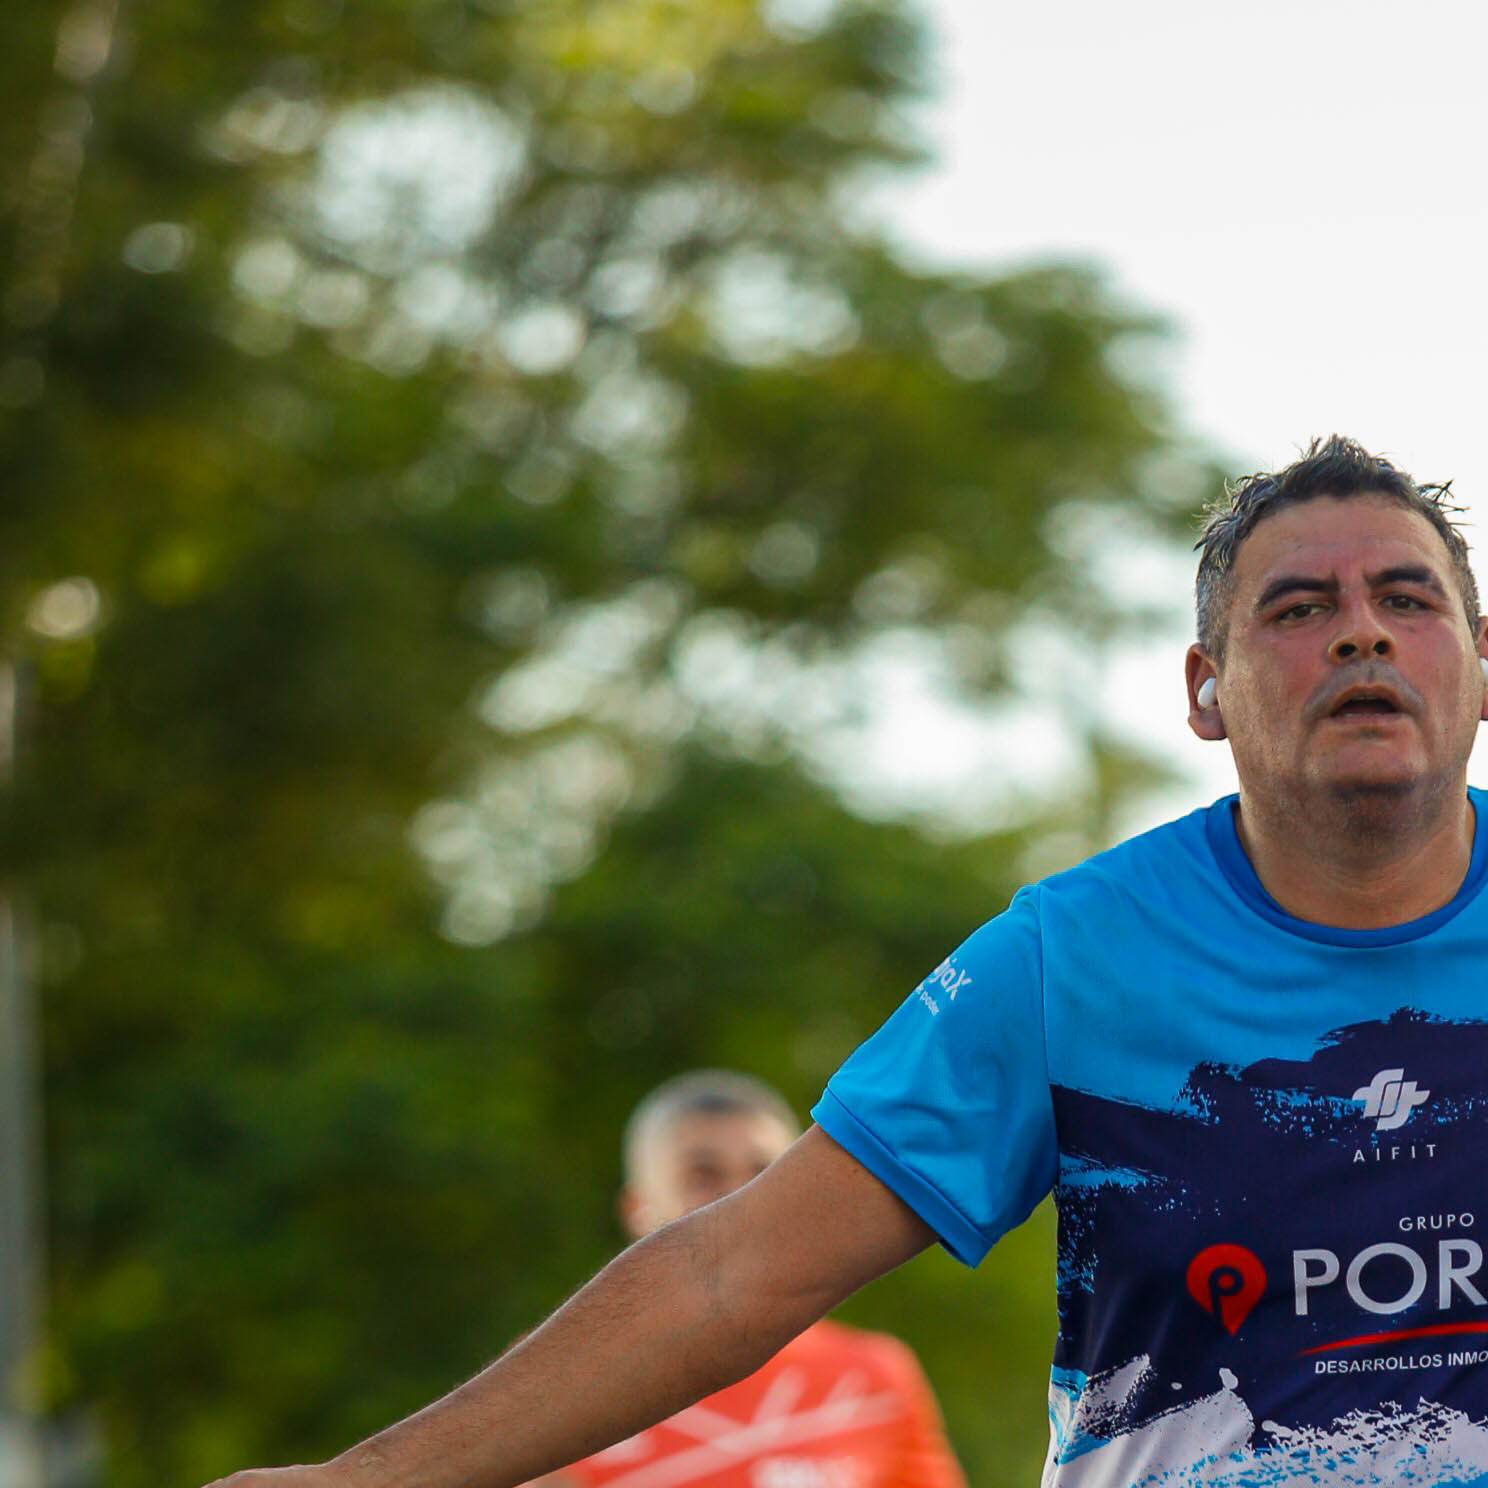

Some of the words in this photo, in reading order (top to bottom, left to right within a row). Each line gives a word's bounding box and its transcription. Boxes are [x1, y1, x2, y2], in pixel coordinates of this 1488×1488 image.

[1353, 1143, 1437, 1163] AIFIT
[1399, 1212, 1475, 1232] GRUPO
[1315, 1354, 1443, 1375] DESARROLLOS
